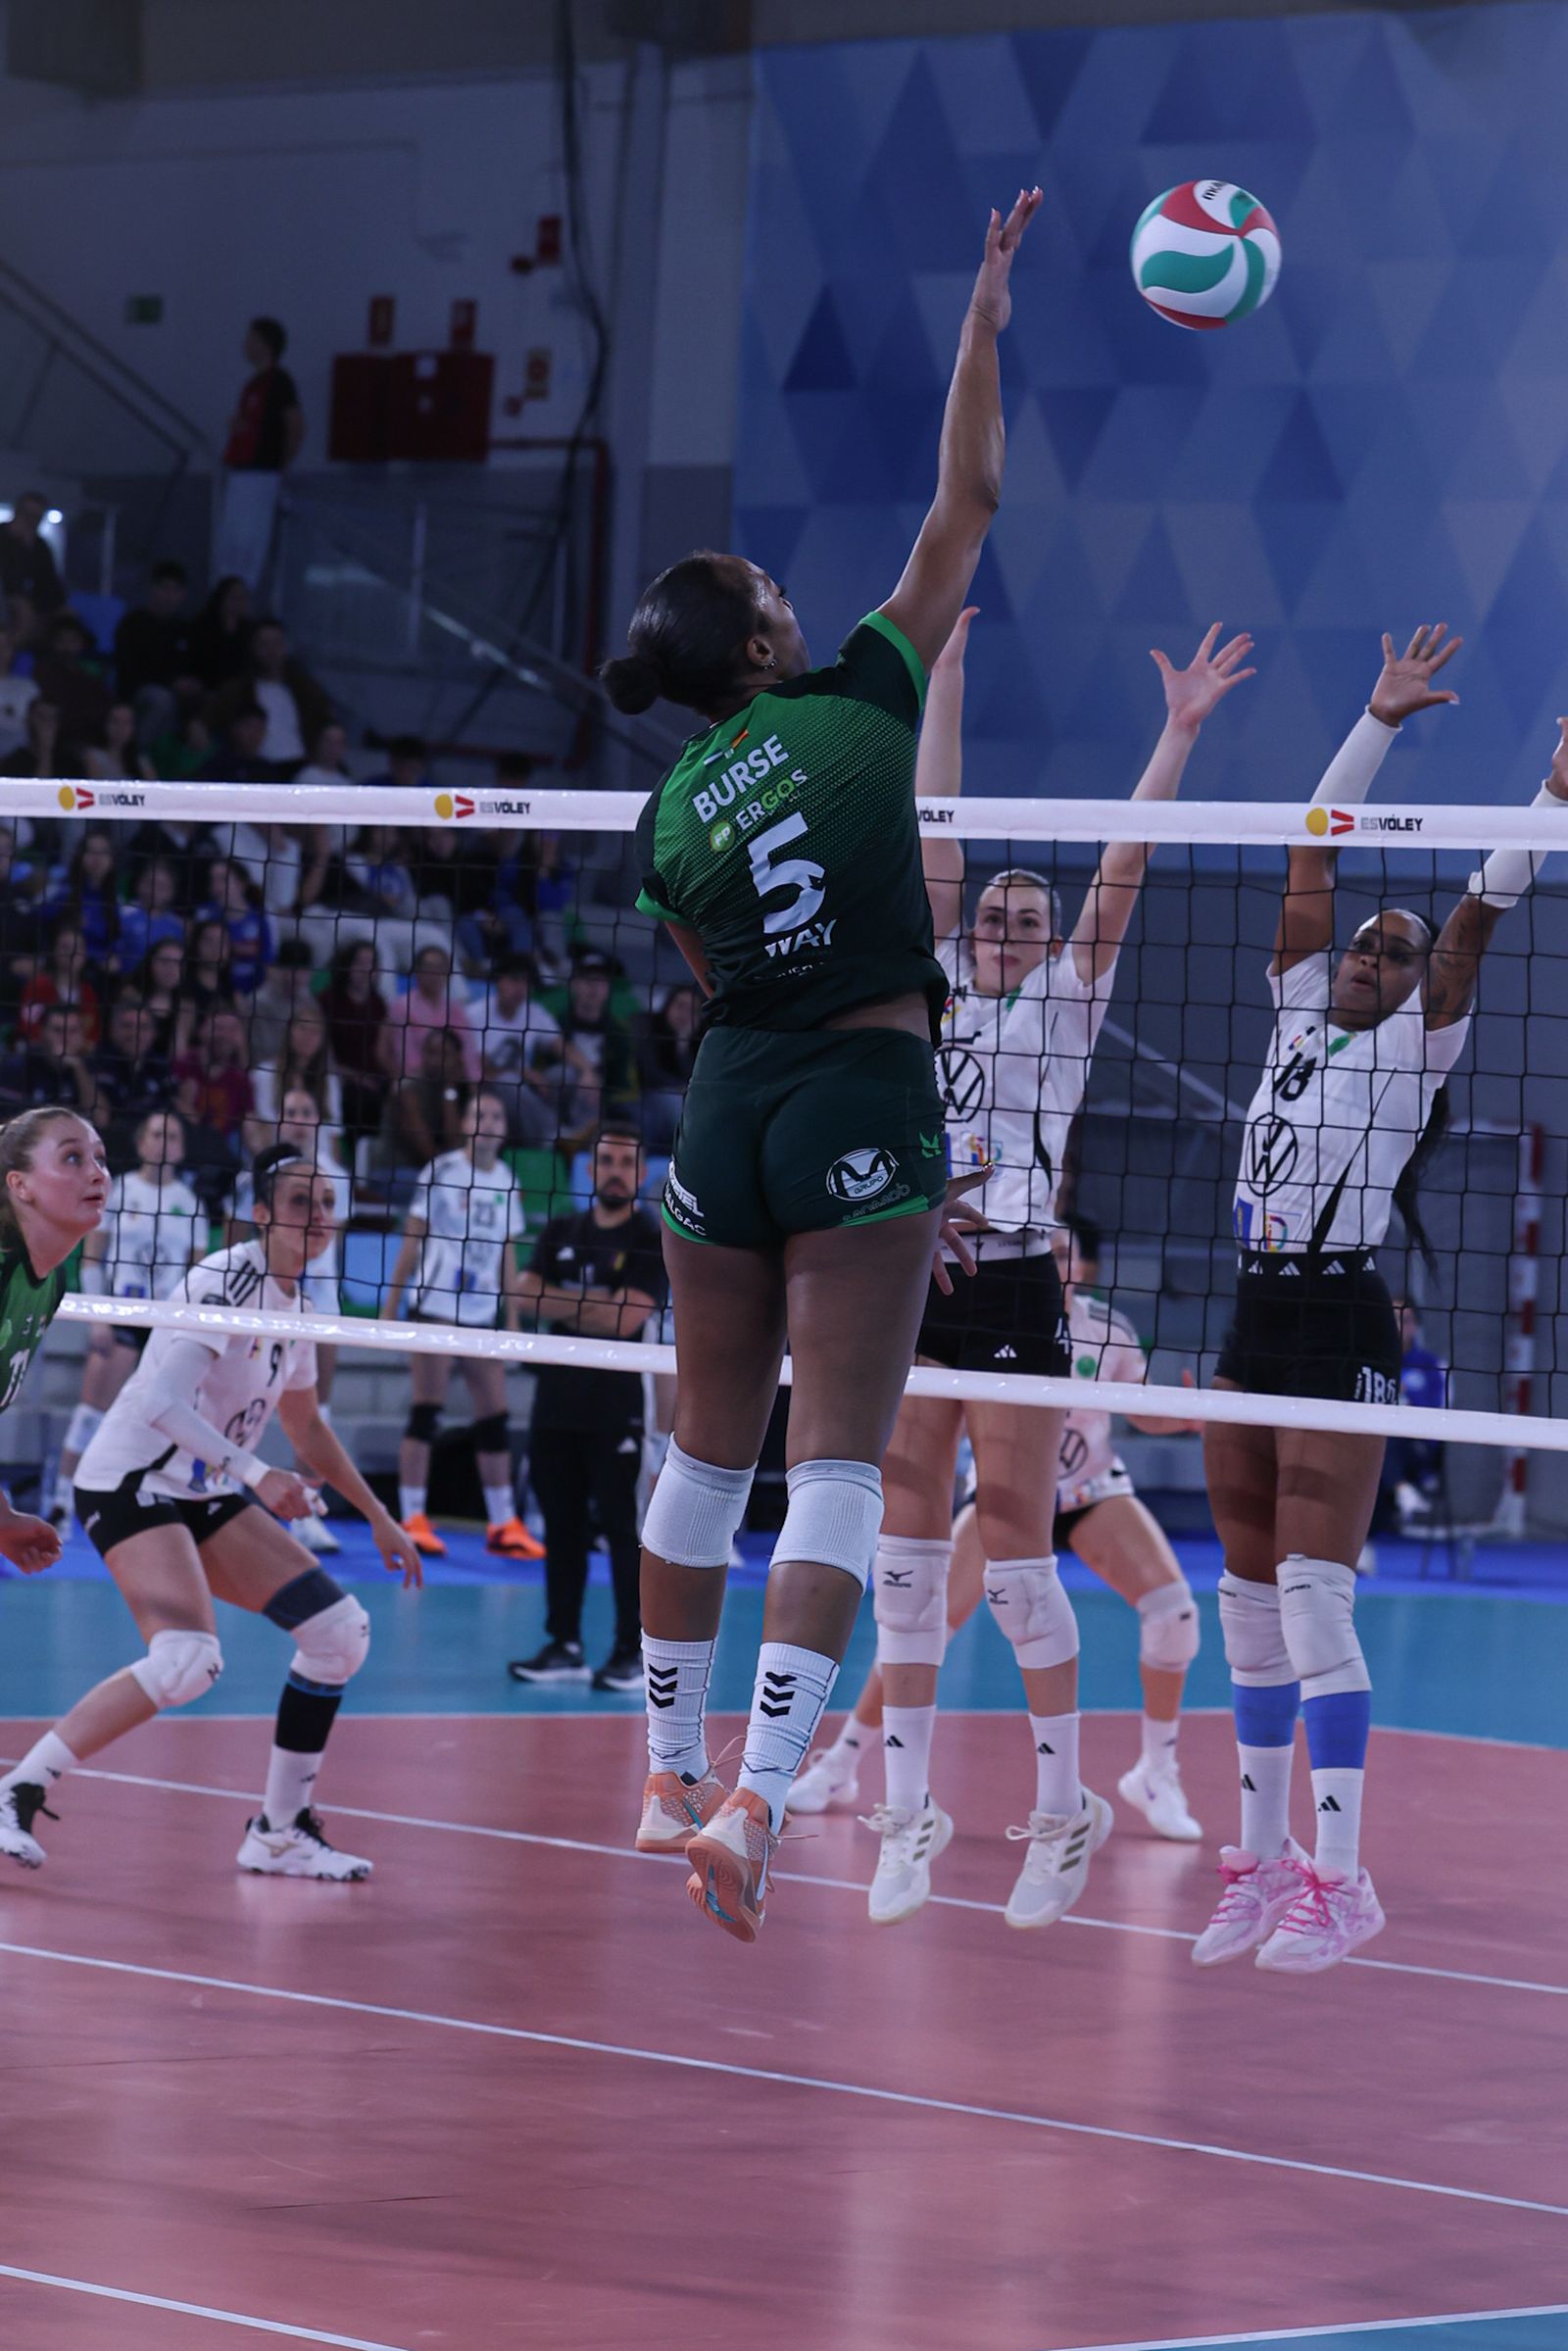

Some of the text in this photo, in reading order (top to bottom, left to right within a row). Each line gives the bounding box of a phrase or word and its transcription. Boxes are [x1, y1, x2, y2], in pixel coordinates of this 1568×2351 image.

[692, 734, 790, 824] BURSE
[735, 769, 808, 831] ERGOS
[747, 810, 827, 934] 5
[764, 918, 838, 957] WAY
